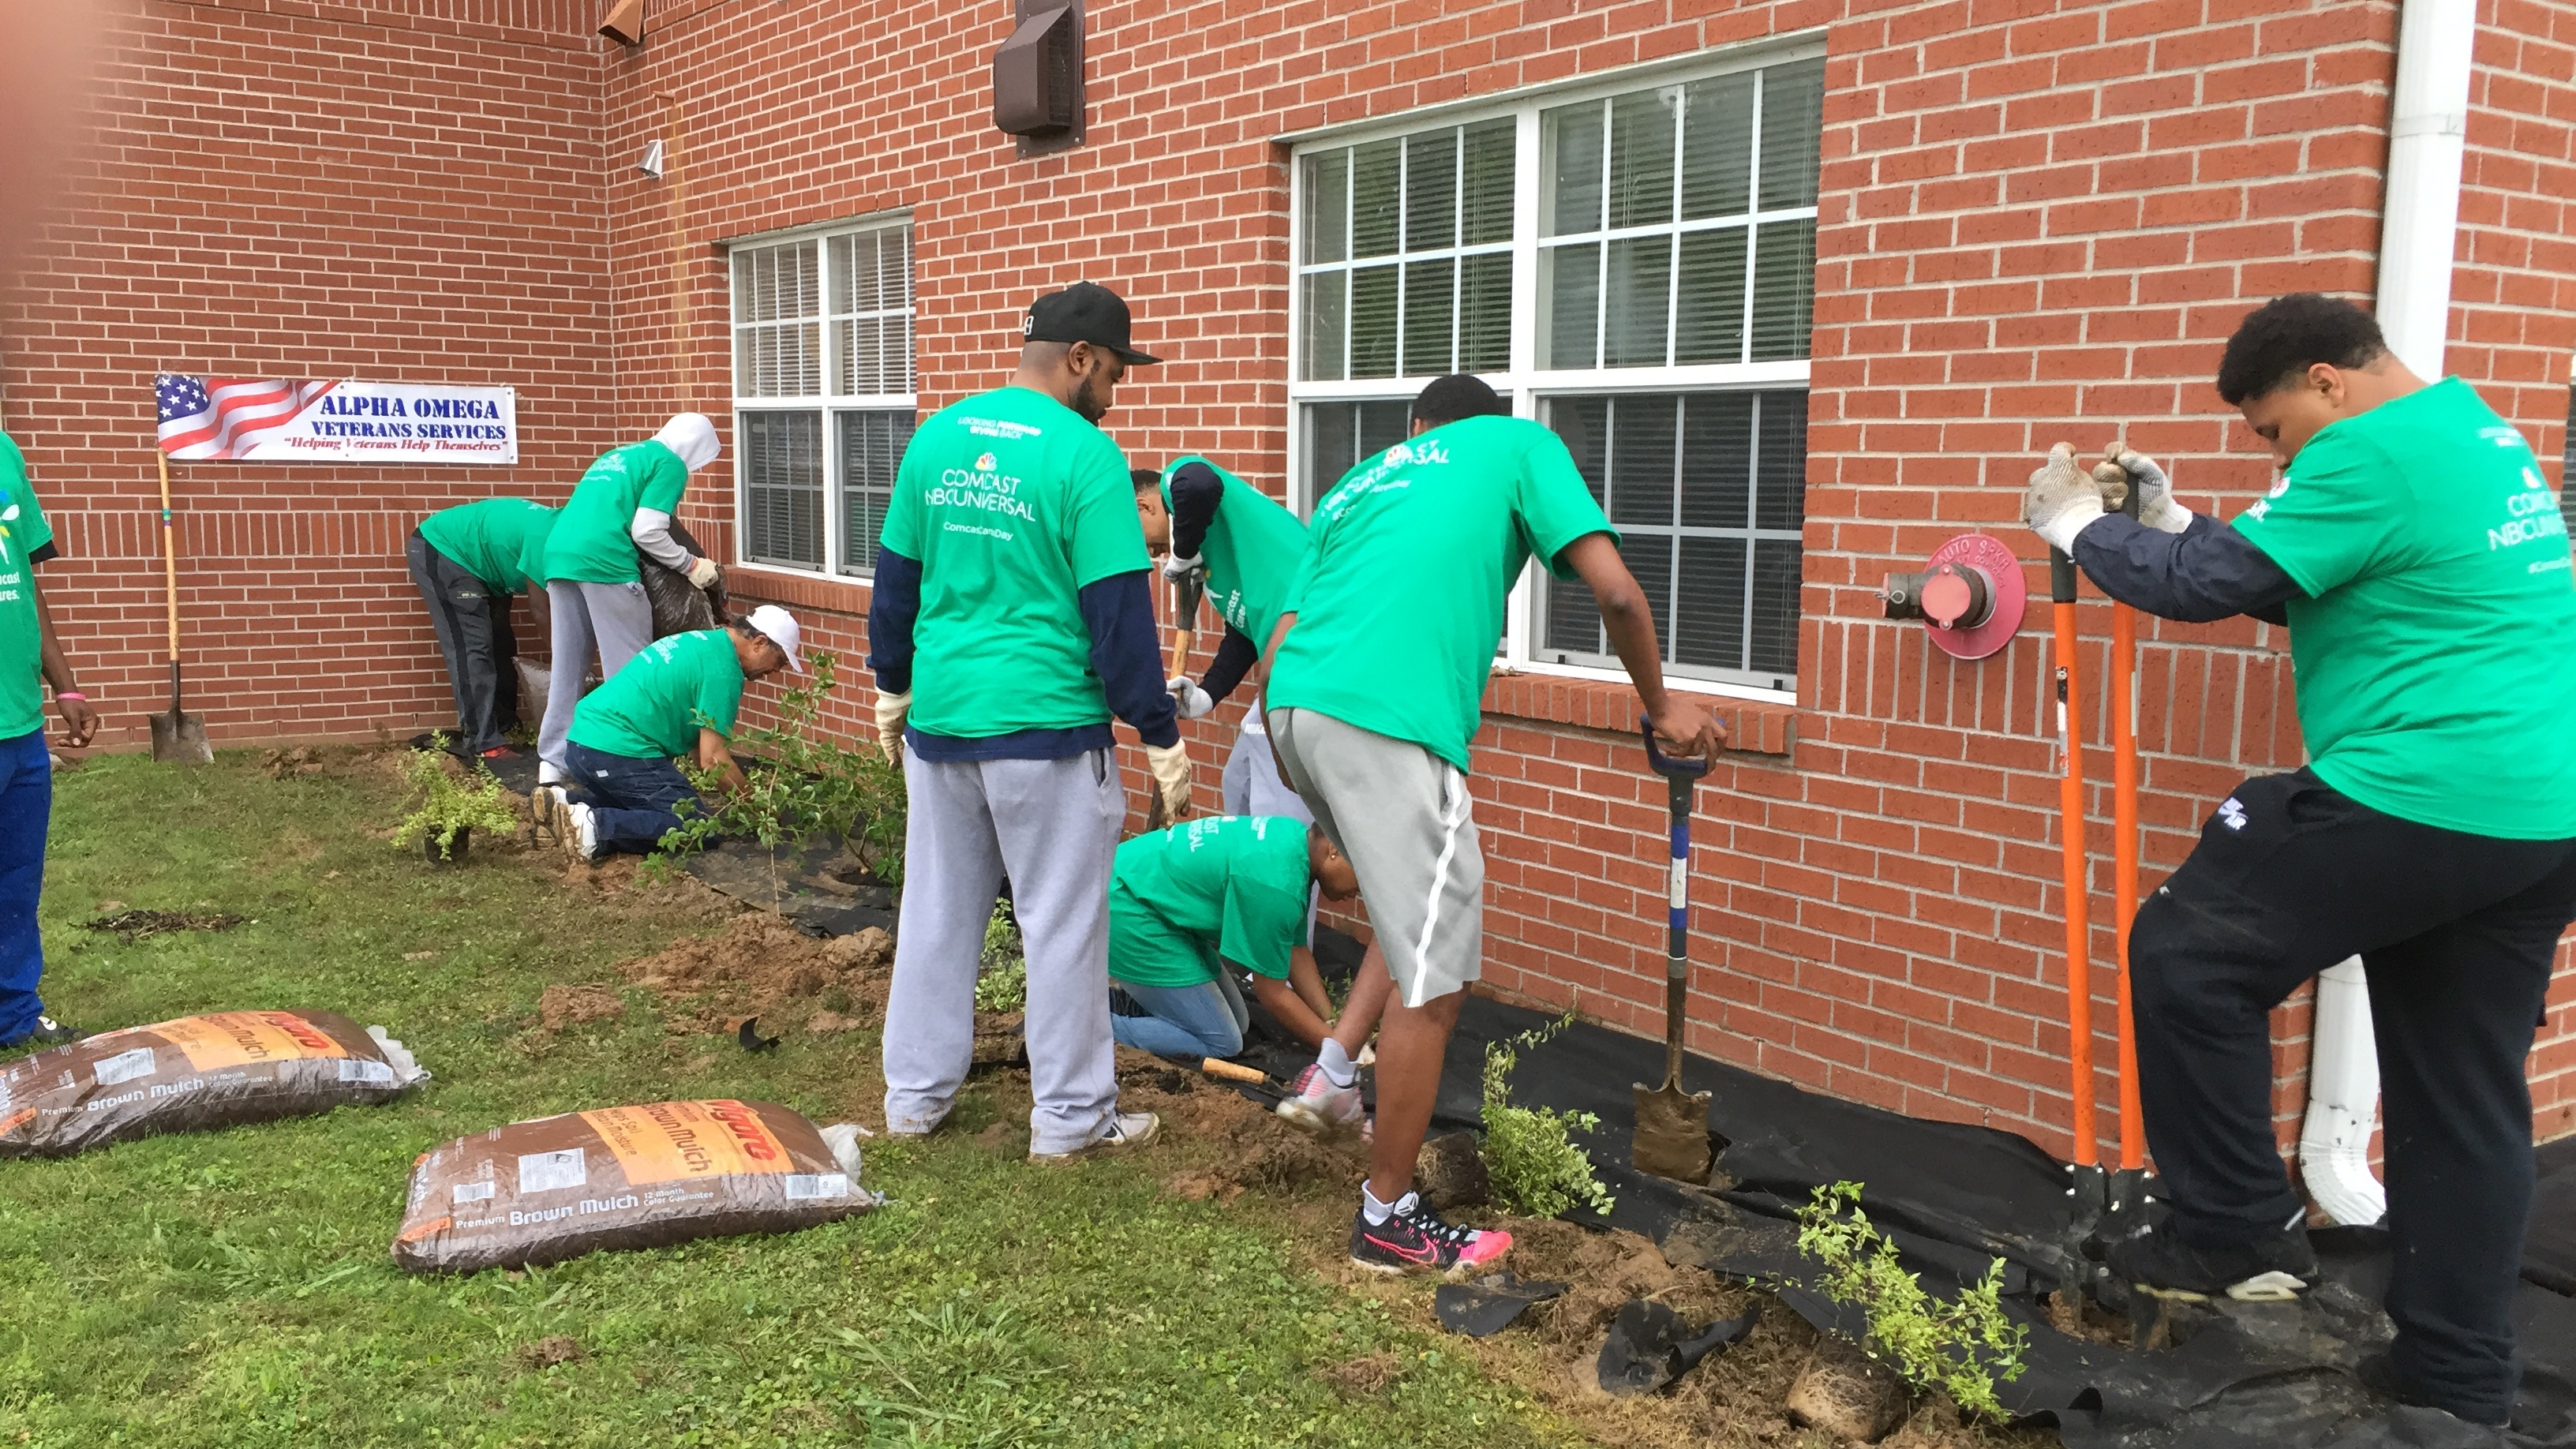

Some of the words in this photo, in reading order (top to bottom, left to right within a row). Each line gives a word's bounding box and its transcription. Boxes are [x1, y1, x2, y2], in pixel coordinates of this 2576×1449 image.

[320, 395, 407, 417] ALPHA
[414, 399, 500, 419] OMEGA
[311, 421, 412, 438] VETERANS
[417, 424, 506, 440] SERVICES
[401, 439, 430, 452] Help
[942, 469, 1021, 495] COMCAST
[925, 488, 1035, 522] NBCUNIVERSAL
[1938, 539, 1970, 565] AUTO
[42, 1105, 84, 1117] Premium
[87, 1089, 144, 1111] Brown
[150, 1076, 204, 1098] Mulch
[667, 1129, 712, 1173] Mulch
[643, 1197, 666, 1207] Color
[668, 1192, 714, 1203] Guarantee
[656, 1188, 684, 1197] Month
[456, 1215, 505, 1230] Premium
[510, 1205, 573, 1226] Brown
[579, 1194, 638, 1215] Mulch
